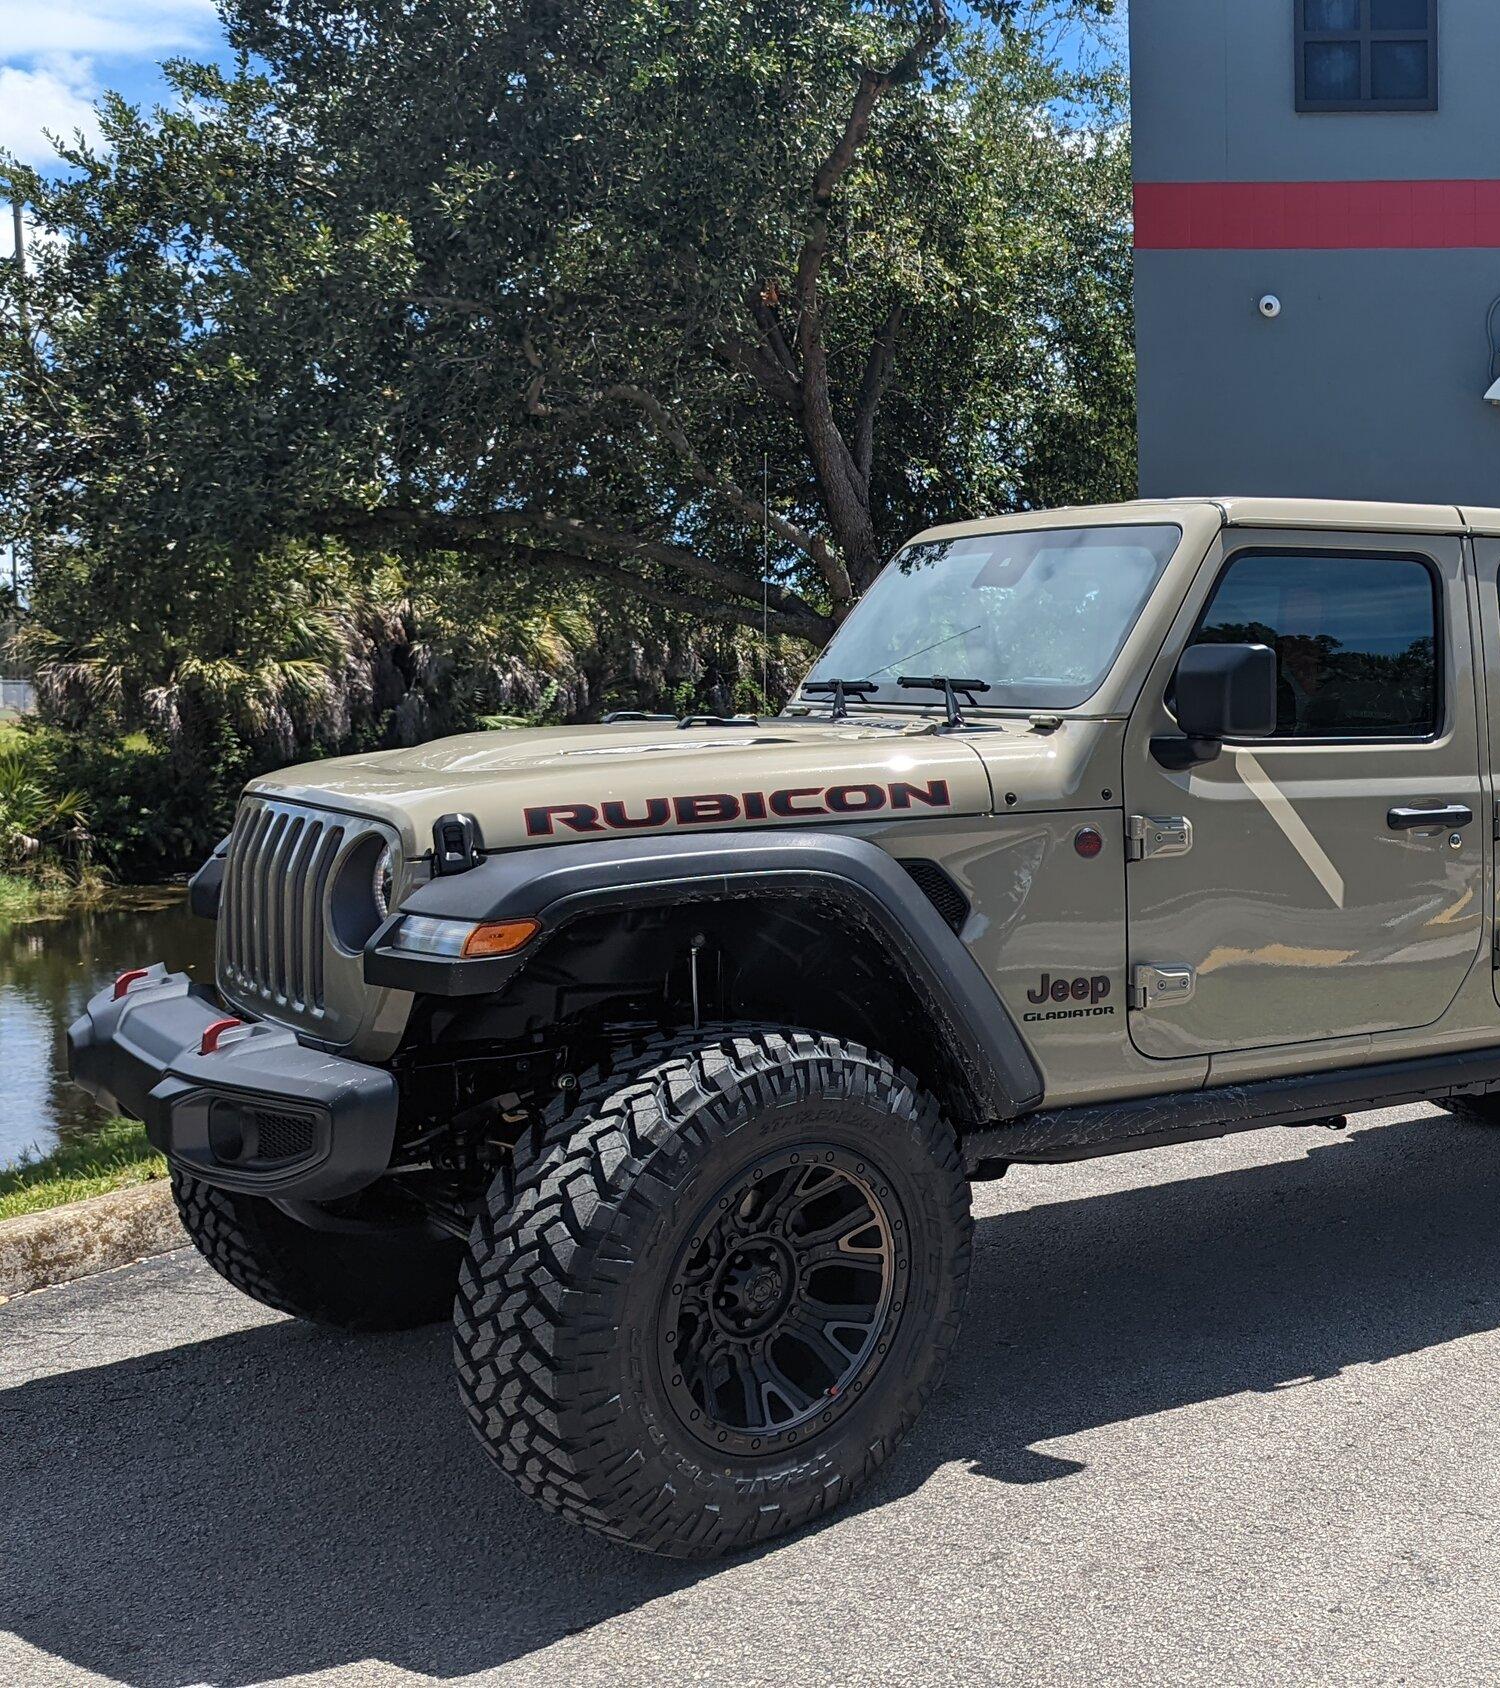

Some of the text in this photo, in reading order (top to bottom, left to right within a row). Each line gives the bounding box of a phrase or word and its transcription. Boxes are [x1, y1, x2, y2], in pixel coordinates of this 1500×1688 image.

[523, 780, 951, 837] RUBICON
[1027, 973, 1111, 1005] Jeep
[1023, 1006, 1115, 1022] GLADIATOR
